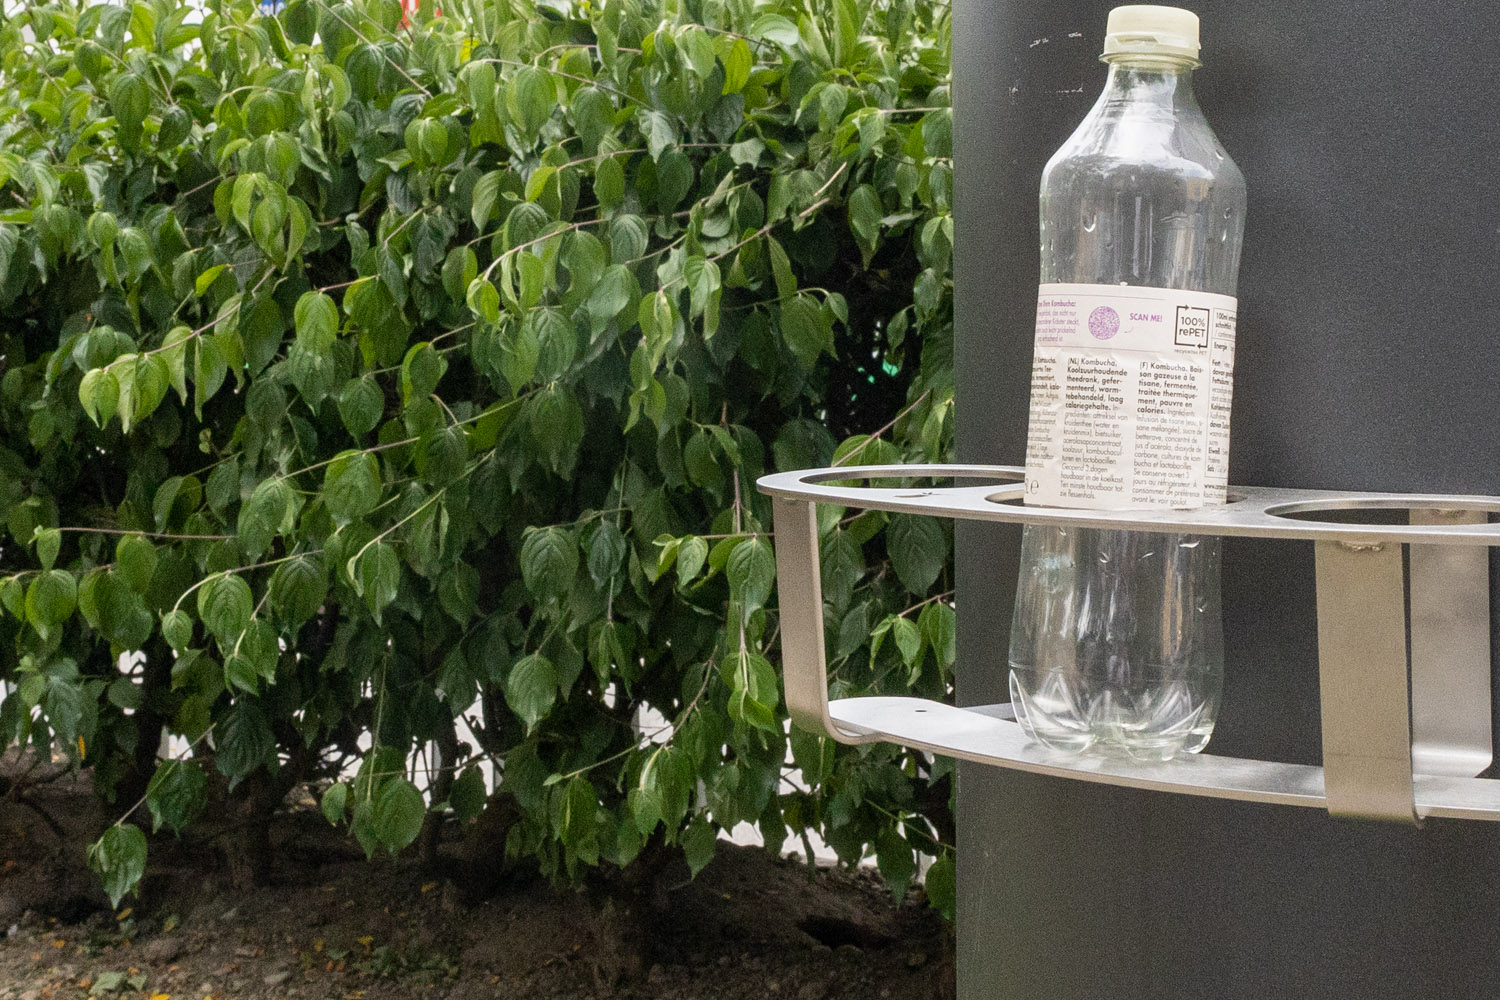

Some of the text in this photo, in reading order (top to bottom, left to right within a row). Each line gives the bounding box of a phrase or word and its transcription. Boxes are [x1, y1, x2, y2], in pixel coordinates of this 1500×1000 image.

[1130, 312, 1163, 322] SCAN ME!
[1181, 316, 1205, 327] 100%
[1179, 328, 1205, 338] rePET
[1067, 366, 1128, 376] Koolzuurhoudende
[1151, 362, 1188, 372] Kombucha.
[1067, 375, 1122, 385] theedrank, gefer-
[1154, 372, 1182, 380] gazeuse
[1066, 384, 1096, 393] menteerd,
[1138, 378, 1199, 391] tisane, fermentée,
[1066, 392, 1106, 402] tebehandeld,
[1108, 394, 1123, 404] laag
[1138, 388, 1198, 400] traitée thermique-
[1066, 401, 1111, 411] caloriegehalte.
[1137, 398, 1157, 406] ment,
[1160, 400, 1184, 408] pauvre
[1136, 406, 1166, 414] calories.
[1090, 464, 1108, 474] dagen
[1132, 487, 1165, 495] consommer
